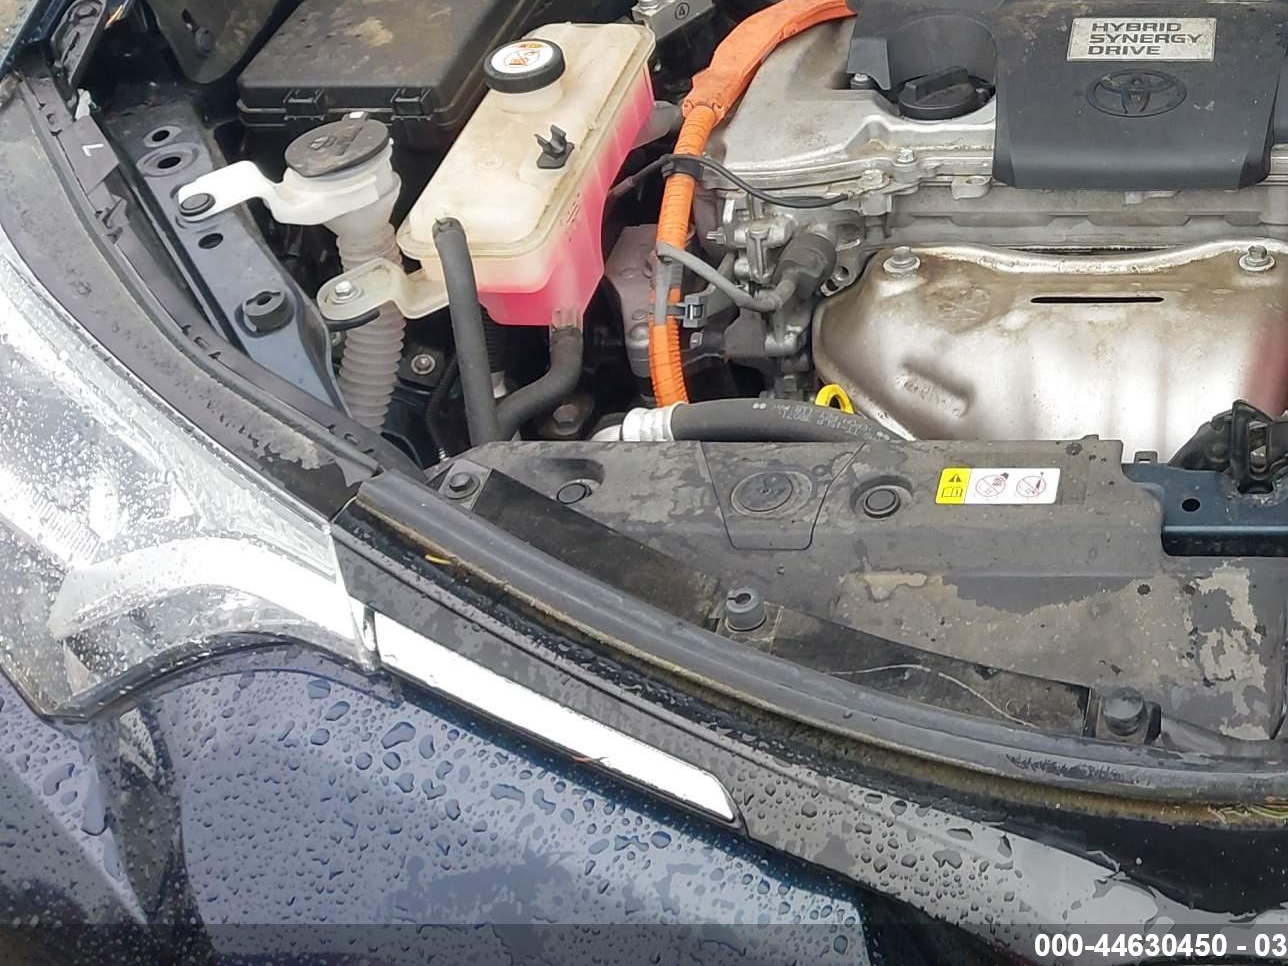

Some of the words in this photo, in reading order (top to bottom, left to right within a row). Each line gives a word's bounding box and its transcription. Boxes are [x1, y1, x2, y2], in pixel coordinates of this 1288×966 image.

[1092, 22, 1182, 32] HYBRID
[1089, 33, 1204, 44] SYNERGY
[1087, 45, 1161, 55] DRIVE
